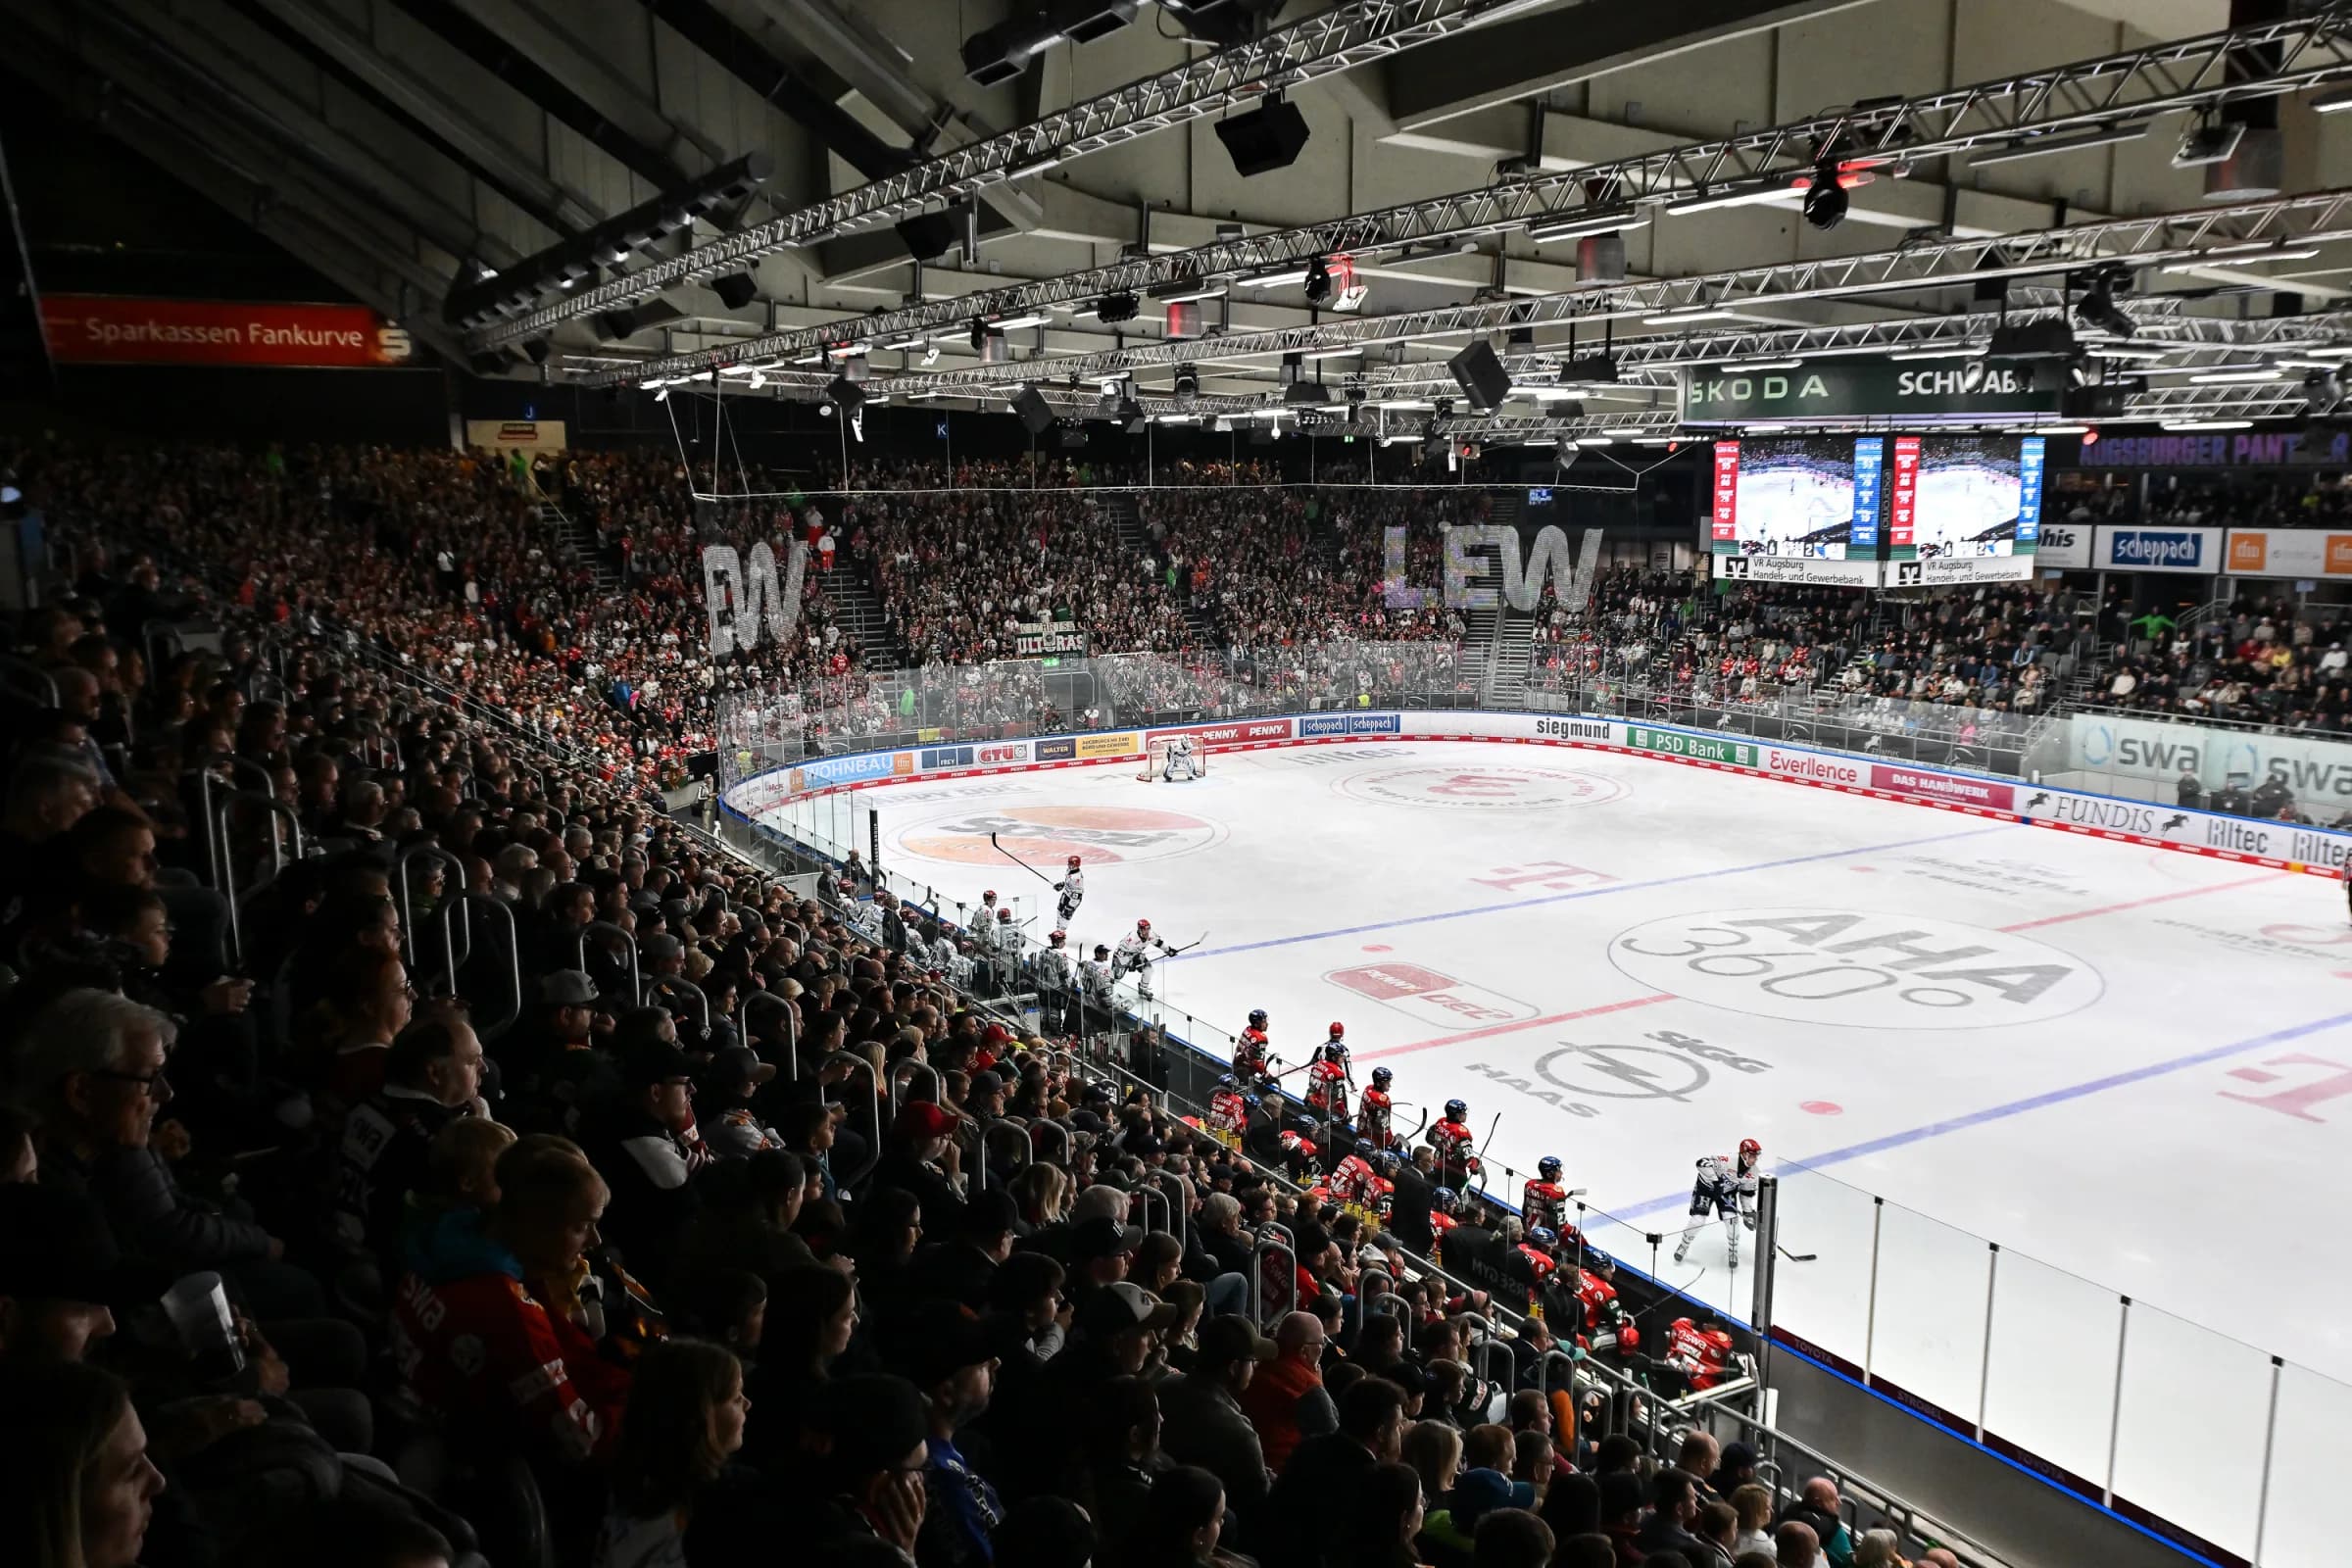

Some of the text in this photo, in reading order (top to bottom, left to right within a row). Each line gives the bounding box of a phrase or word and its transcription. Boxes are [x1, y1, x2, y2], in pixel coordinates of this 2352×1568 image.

[86, 318, 364, 348] Sparkassen Fankurve
[2080, 434, 2228, 466] AUGSBURGER
[2117, 531, 2195, 566] scheppach
[1384, 524, 1604, 612] LEW
[1753, 557, 1804, 571] VR Augsburg
[1927, 561, 1973, 571] VR Augsburg
[1960, 571, 1973, 581] und
[1976, 570, 2022, 580] Gewerbebank
[1753, 571, 1864, 585] Handels- und Gewerbebank
[1202, 728, 1239, 740] PENNY.
[1249, 724, 1285, 737] PENNY.
[1307, 717, 1344, 735] scheppach
[1353, 714, 1392, 734] scheppach
[1537, 717, 1610, 740] siegmund
[979, 744, 1014, 762] GTÜ
[1042, 745, 1069, 755] WALTER
[1655, 734, 1725, 761] PSD Bank
[2119, 738, 2200, 773] swa
[805, 755, 894, 781] WOHNBAU
[1770, 751, 1857, 782] Everllence
[2268, 757, 2352, 796] swa
[1892, 773, 1916, 786] DAS
[1919, 778, 1989, 800] HANDWERK
[2054, 797, 2155, 833] FUNDIS
[1722, 913, 2075, 1005] AHA
[1465, 1061, 1601, 1118] HAAS
[1685, 1334, 1708, 1349] swa
[1793, 1338, 1835, 1367] TOYOTA
